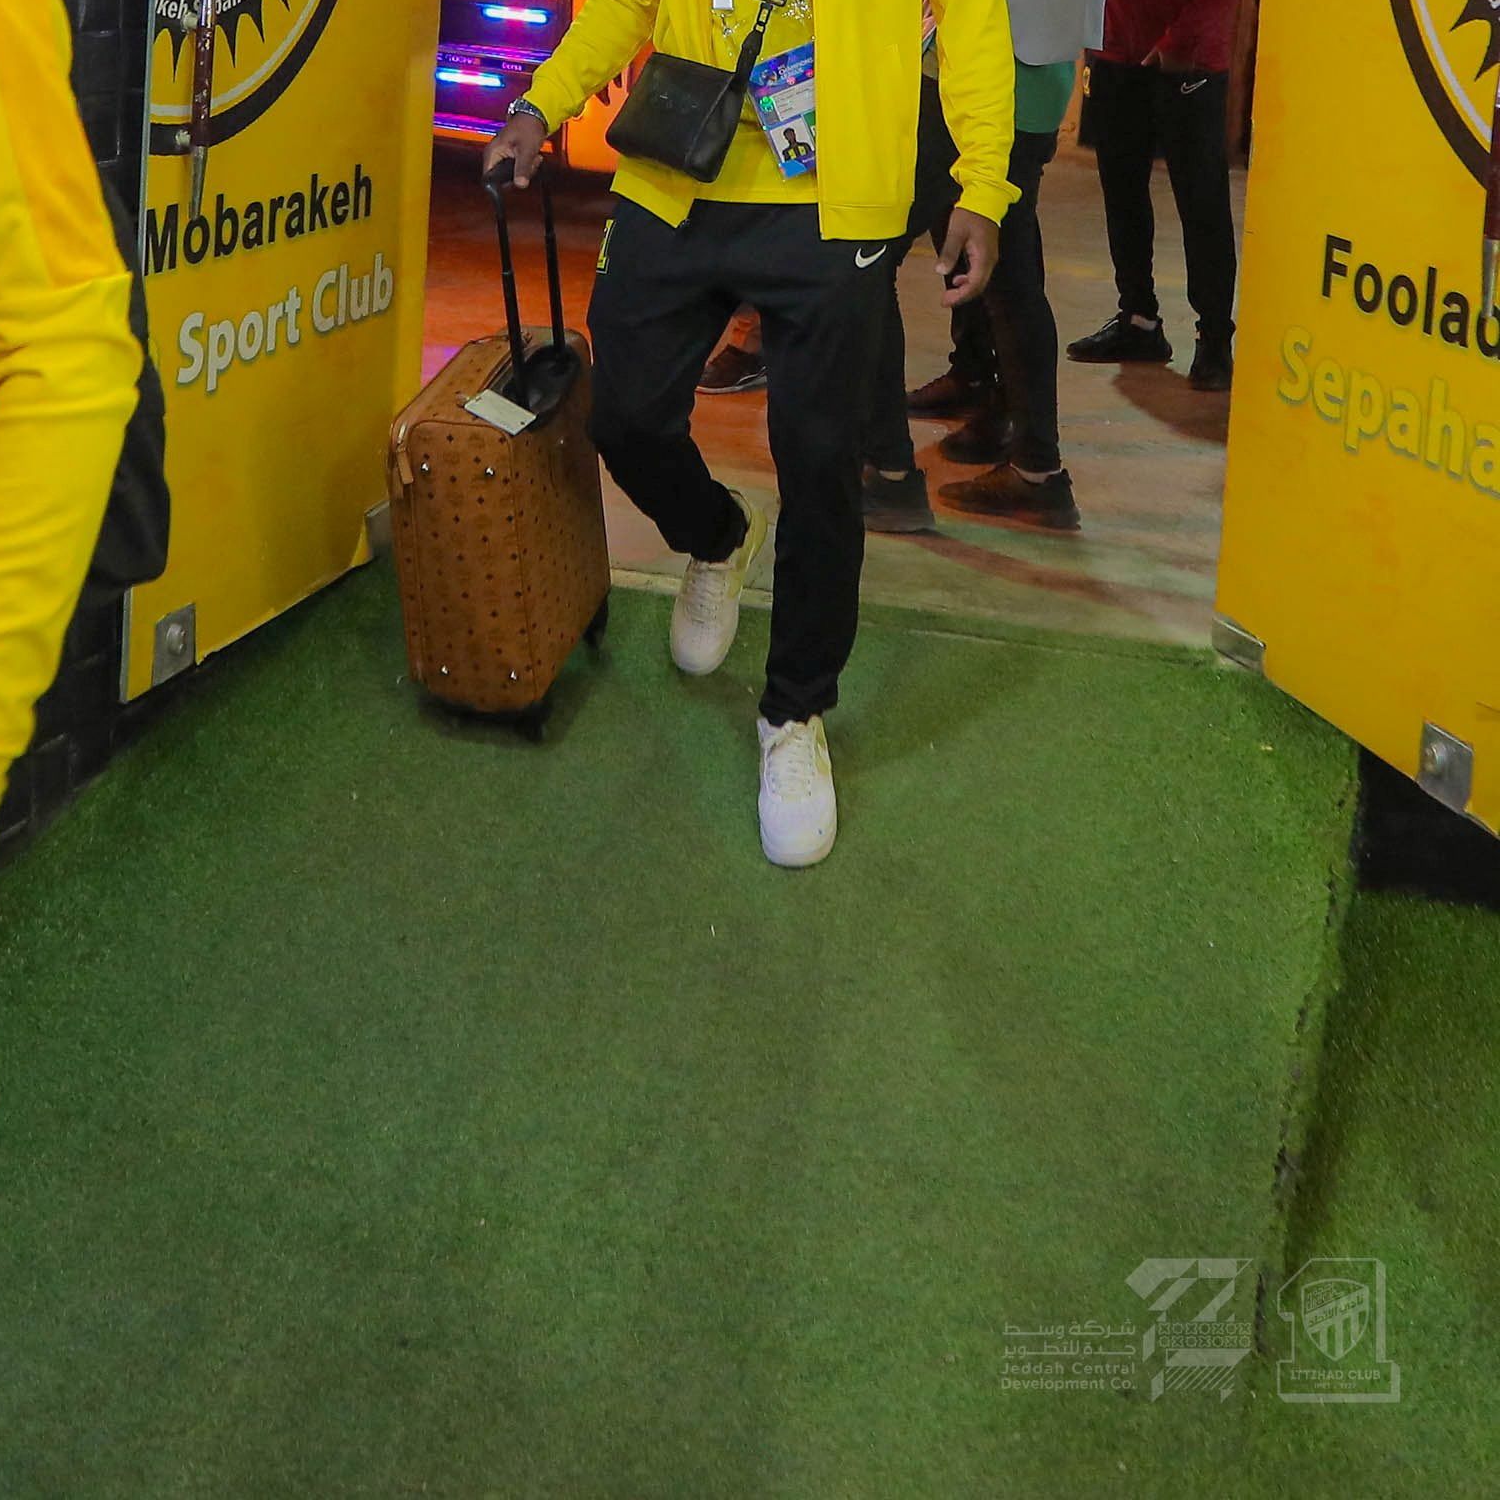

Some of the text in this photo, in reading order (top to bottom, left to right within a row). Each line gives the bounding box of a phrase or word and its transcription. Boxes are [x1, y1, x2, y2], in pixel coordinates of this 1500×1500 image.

[144, 164, 373, 277] Mobarakeh
[176, 251, 394, 393] Sport Club
